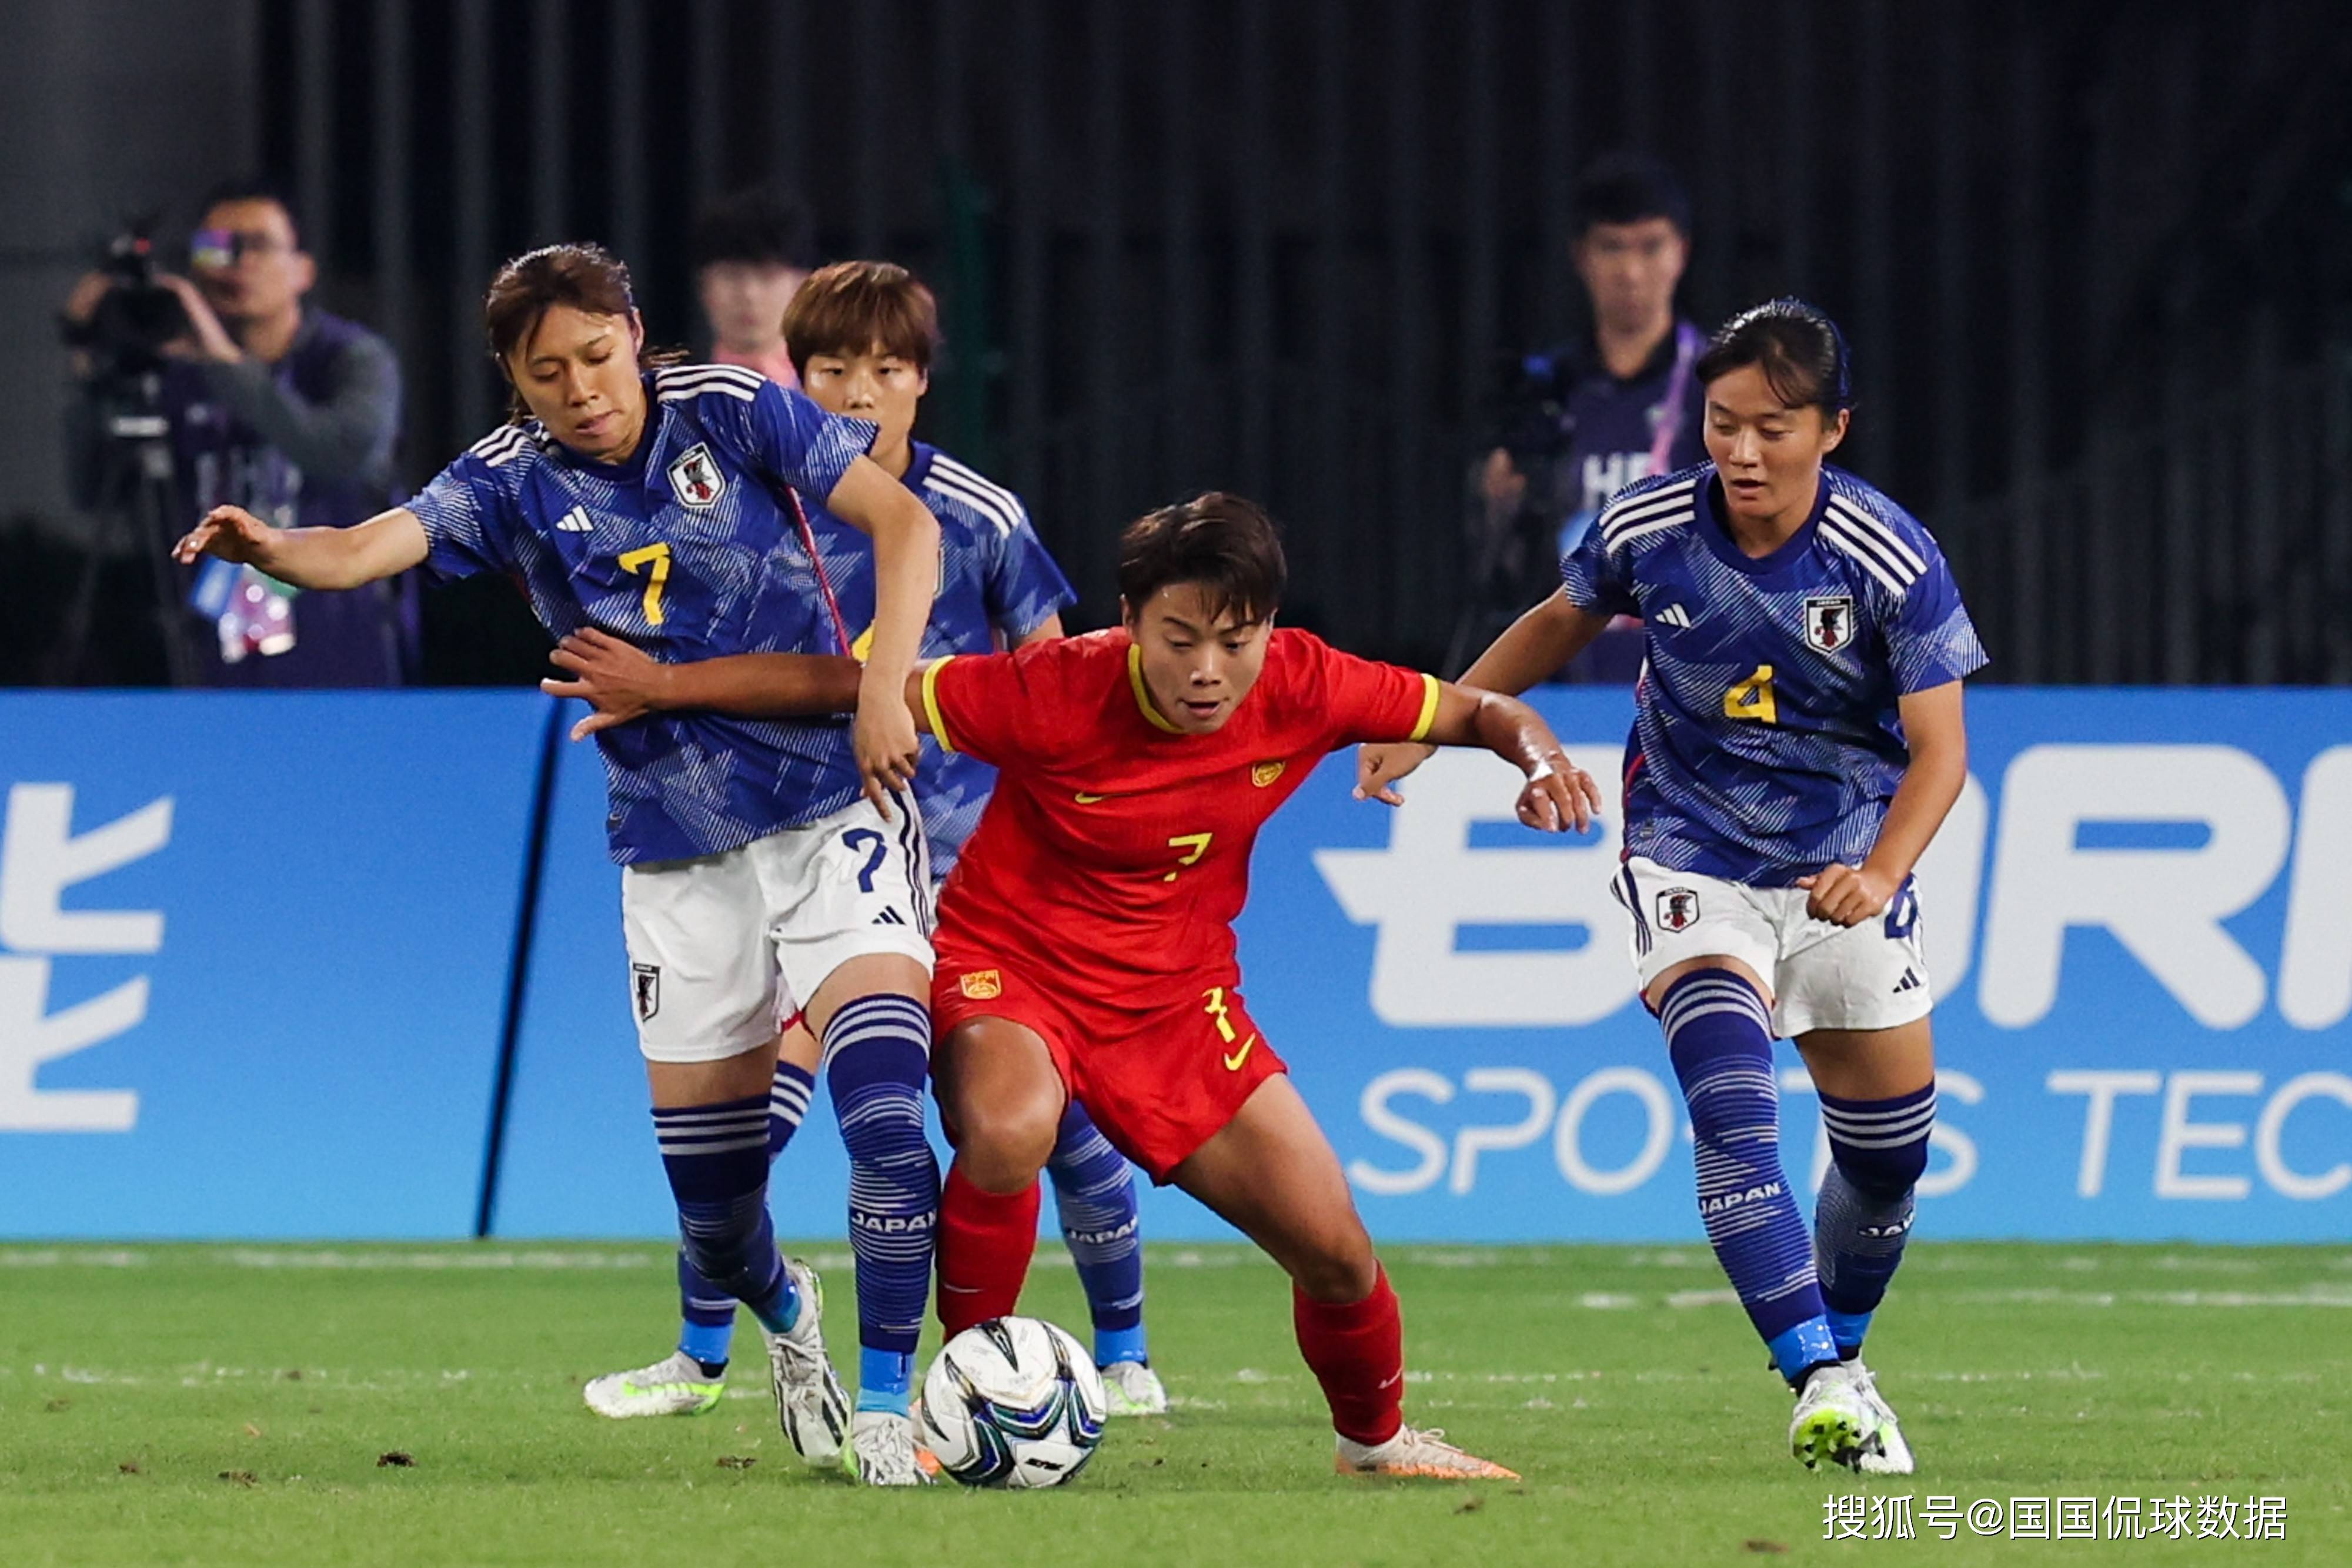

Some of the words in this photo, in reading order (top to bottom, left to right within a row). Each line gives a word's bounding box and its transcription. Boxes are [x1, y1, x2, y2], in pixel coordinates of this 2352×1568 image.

[618, 541, 670, 626] 7
[1724, 664, 1776, 724] 4
[841, 827, 888, 893] 7
[1164, 832, 1212, 882] 7
[1701, 1182, 1781, 1215] JAPAN
